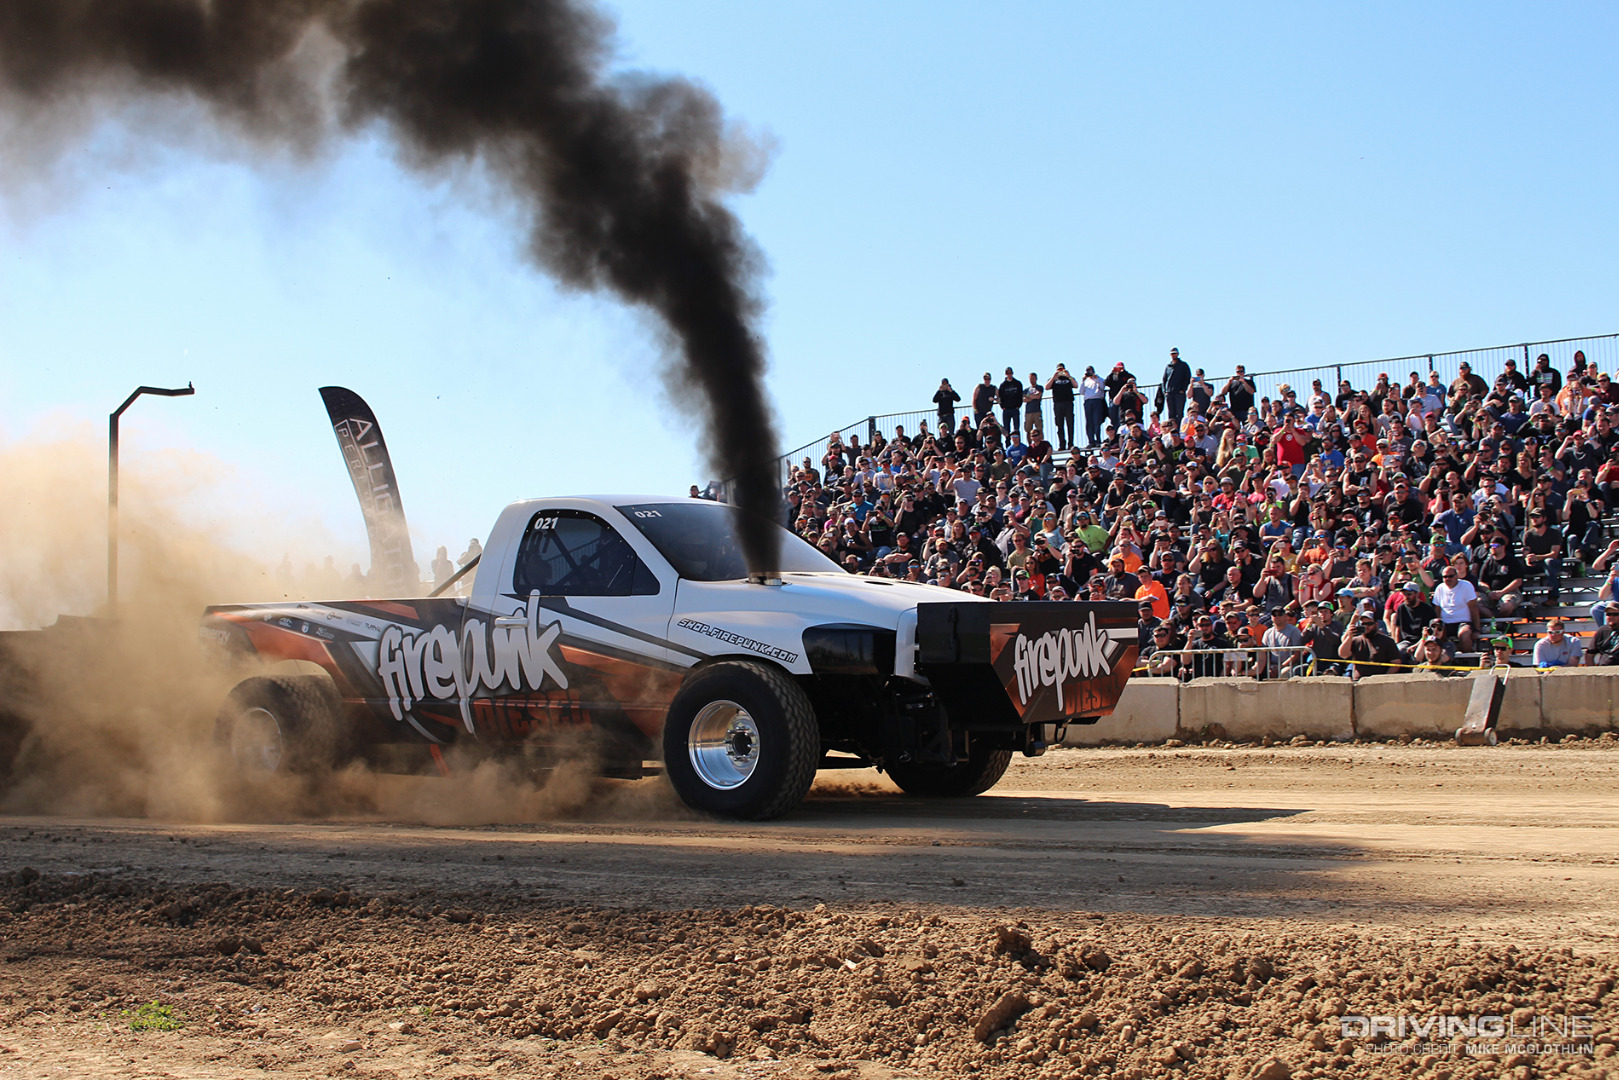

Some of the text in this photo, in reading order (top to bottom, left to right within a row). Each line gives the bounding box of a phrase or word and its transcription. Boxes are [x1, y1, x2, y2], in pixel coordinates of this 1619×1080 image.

[534, 517, 558, 530] 021
[634, 510, 662, 518] 021
[378, 589, 568, 733] firepunk
[677, 618, 799, 664] SHOP.FIREPUNK.COM
[1014, 611, 1111, 711] firepunk
[1064, 673, 1121, 715] DIESEL
